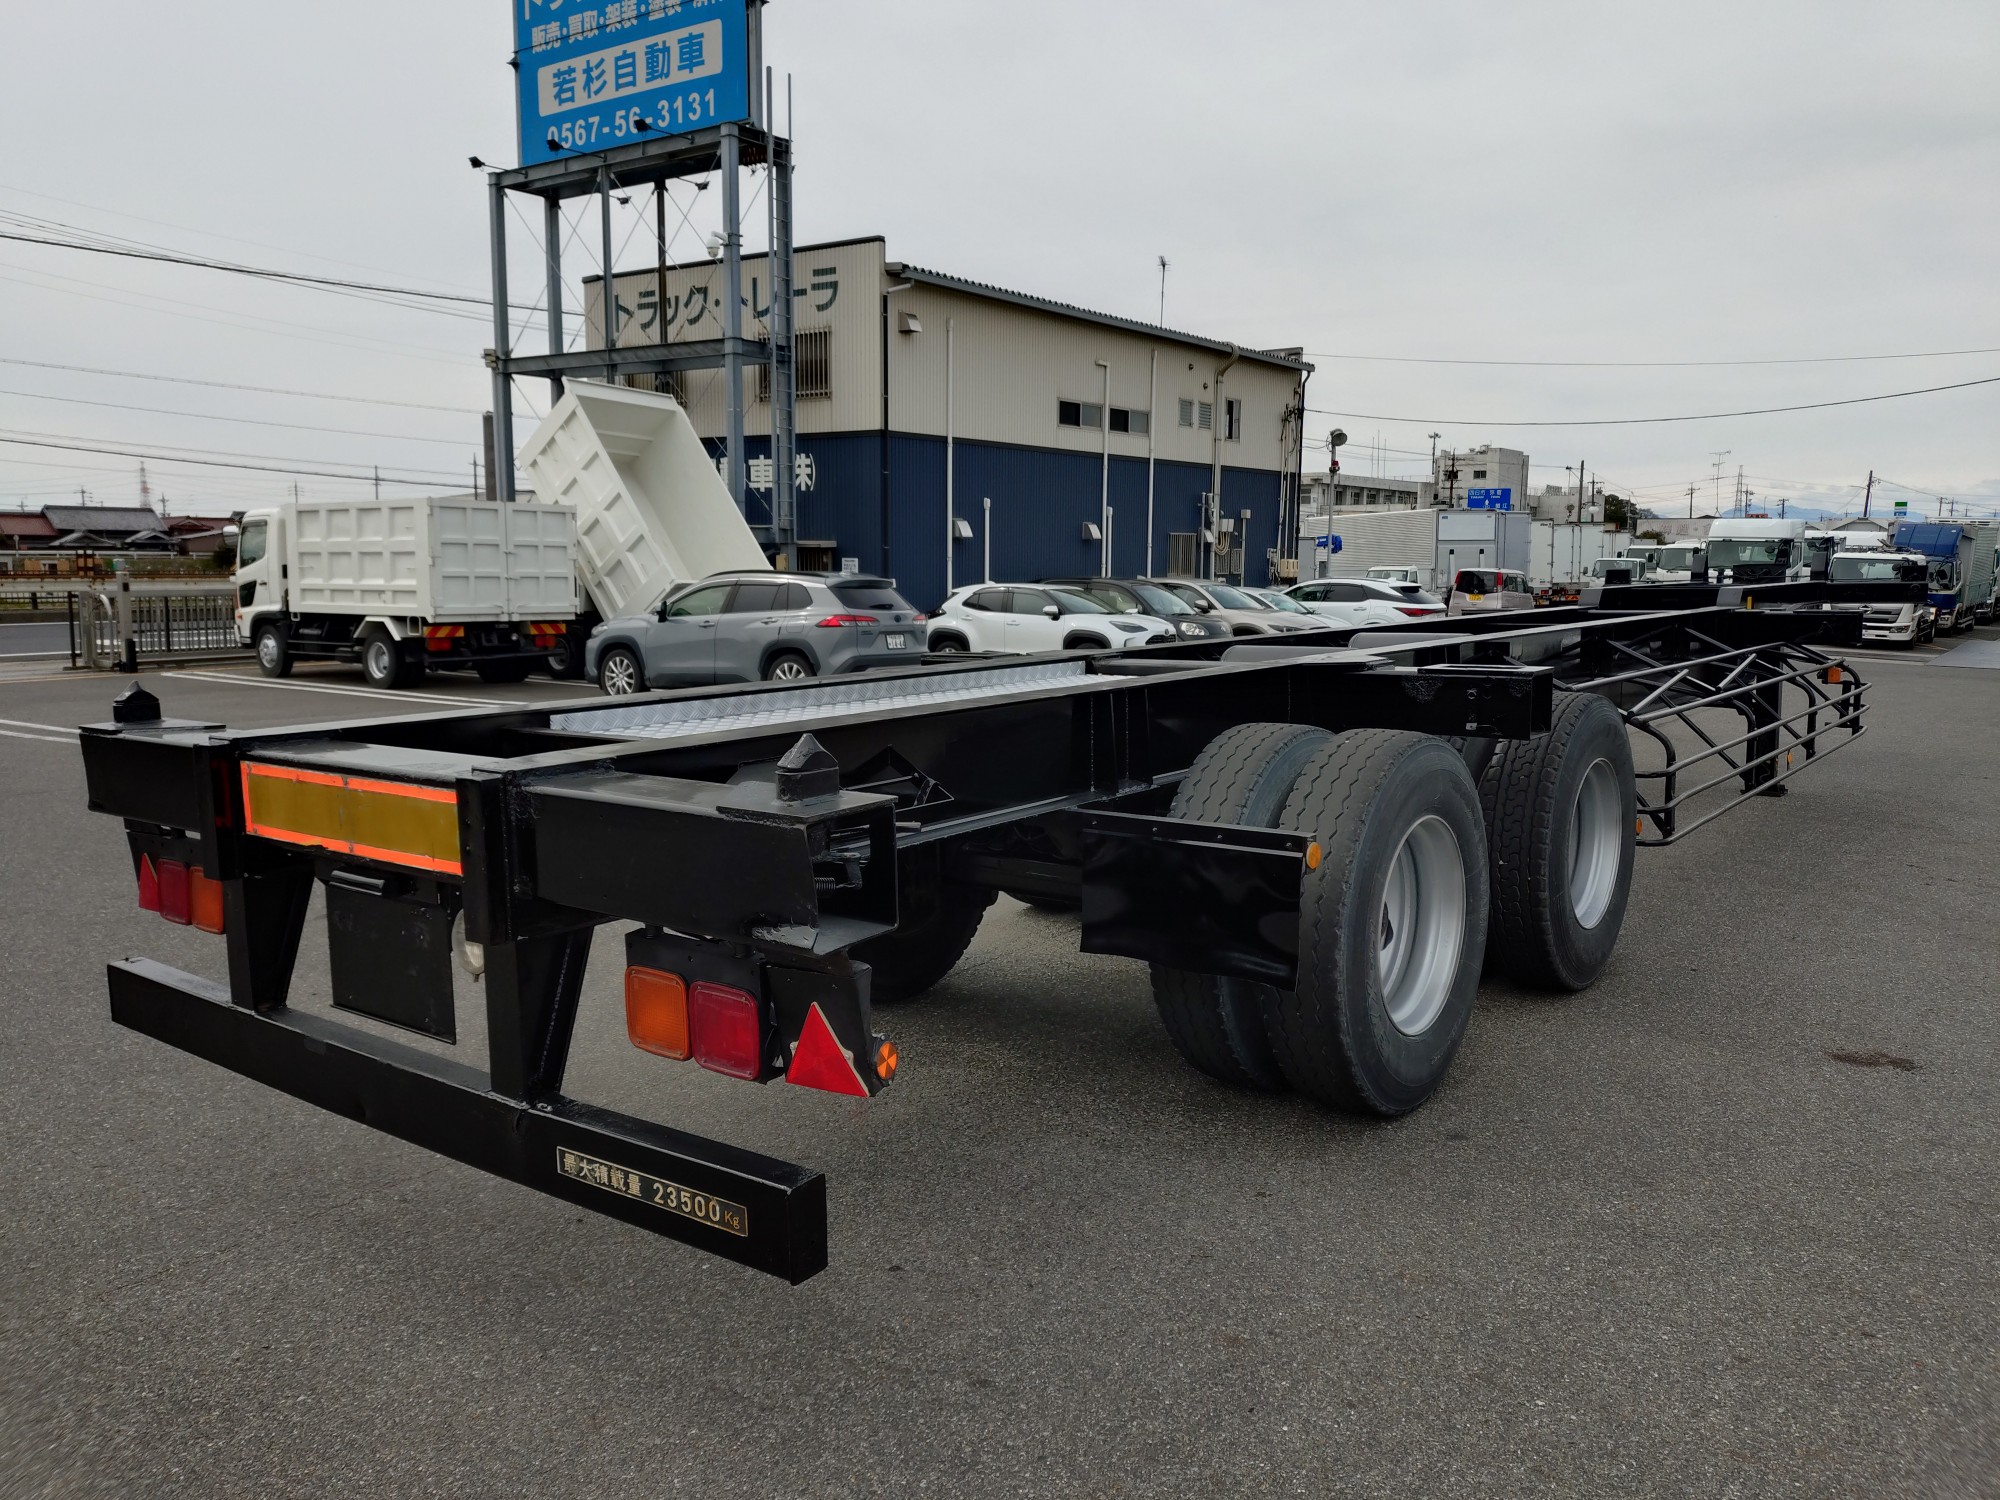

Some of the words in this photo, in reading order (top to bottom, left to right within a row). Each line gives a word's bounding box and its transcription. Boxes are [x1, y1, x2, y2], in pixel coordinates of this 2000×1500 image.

[552, 32, 705, 106] 若杉自動車
[547, 88, 715, 149] 0567-56-3131
[563, 1153, 642, 1197] 最大積載量
[652, 1182, 720, 1222] 23500
[723, 1210, 740, 1229] Kg
